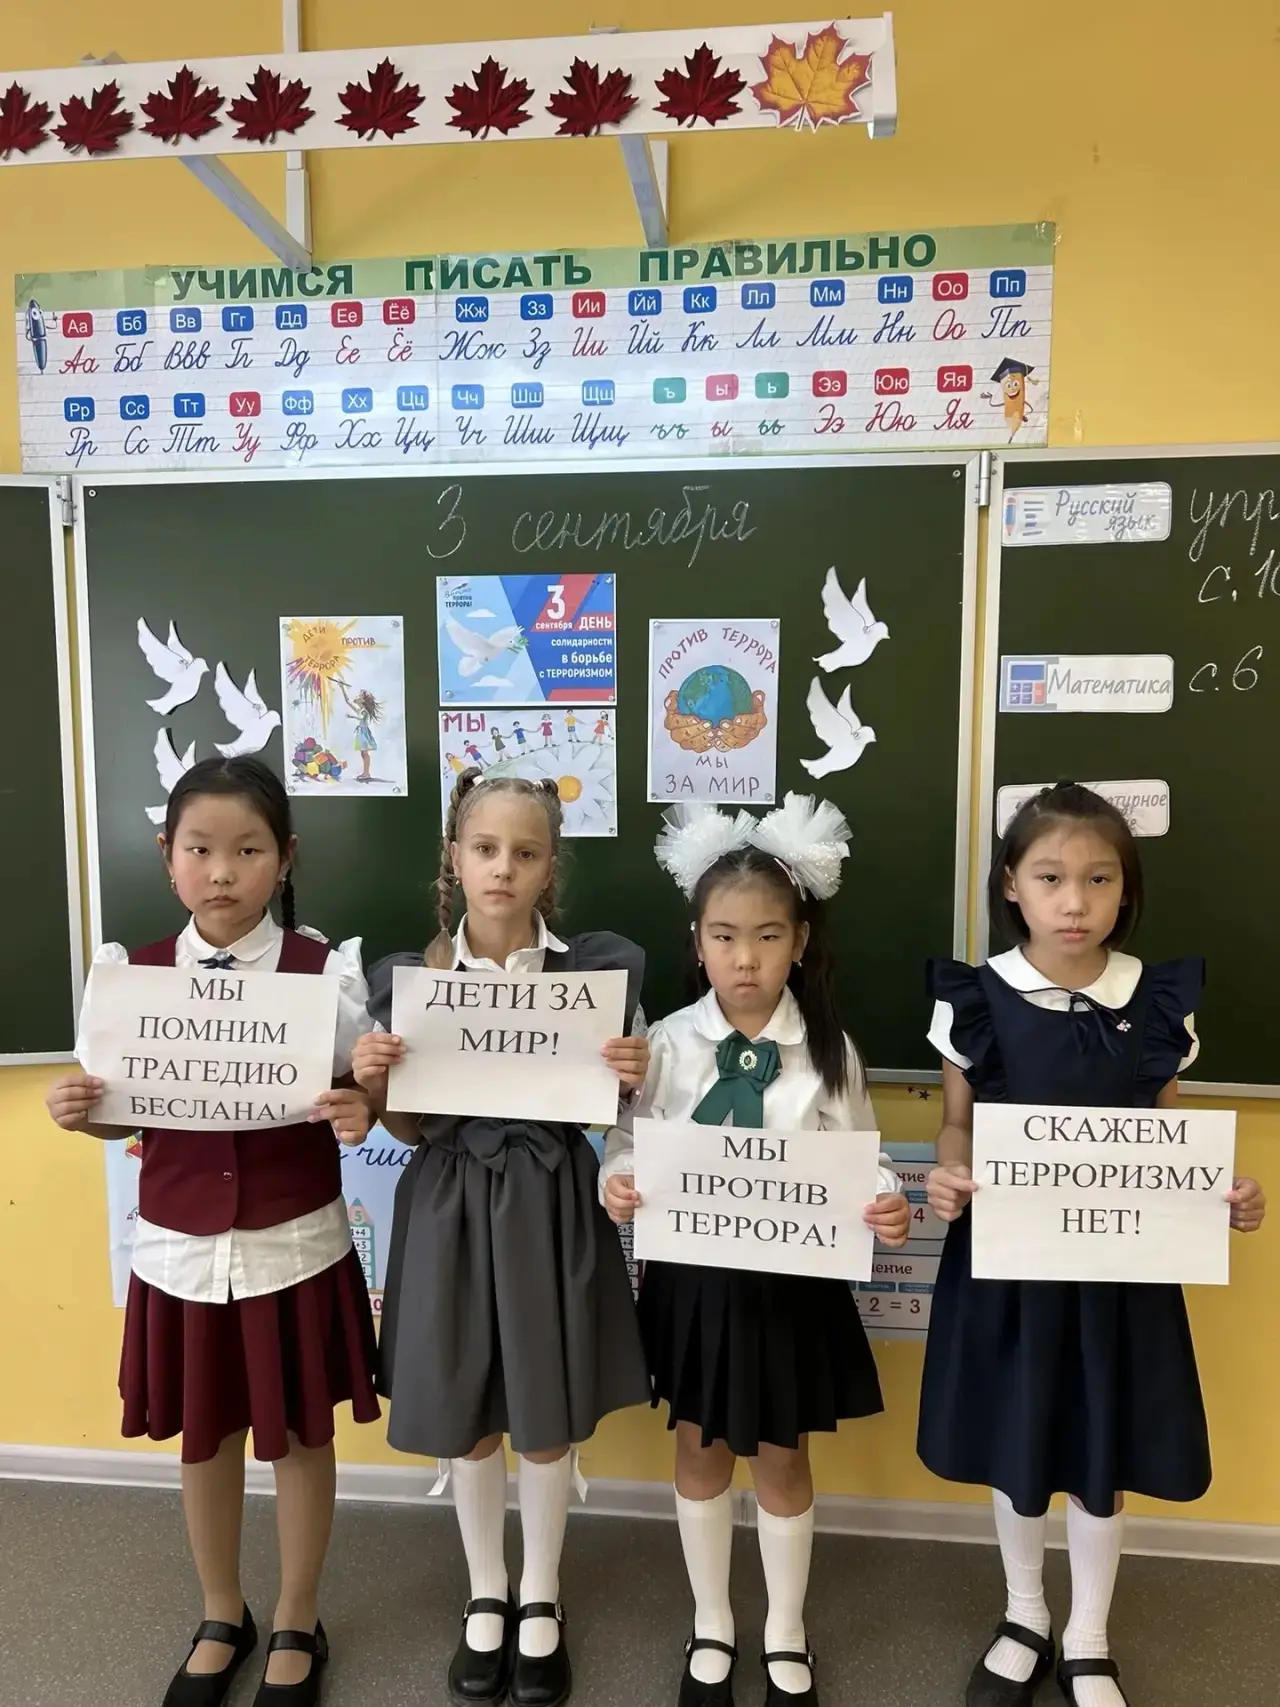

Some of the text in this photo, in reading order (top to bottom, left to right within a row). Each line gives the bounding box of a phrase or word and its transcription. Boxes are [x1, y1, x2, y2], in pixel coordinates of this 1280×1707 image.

[170, 233, 937, 300] УЧИМСЯ ПИСАТЬ ПРАВИЛЬНО
[68, 277, 1020, 334] Аа Бб Вв Гг Дд Ее Ёё Жж Зз Ии Йй Кк Лл Мм Нн Оо Пп
[59, 345, 100, 374] Аа
[114, 341, 154, 373] Бб
[225, 338, 254, 369] Гг
[275, 338, 310, 378] Дд
[336, 335, 361, 364] Ее
[388, 328, 413, 362] Ёё
[439, 330, 506, 360] Жж
[523, 327, 551, 369] Зз
[572, 327, 608, 356] Ии
[628, 319, 664, 354] Йй
[682, 320, 719, 352] Кк
[736, 318, 781, 348] Лл
[796, 314, 858, 346] Мм
[873, 310, 916, 343] Нн
[933, 308, 967, 341] Оо
[981, 305, 1032, 339] Пп
[70, 403, 90, 420] Рр
[125, 402, 145, 415] Сс
[180, 399, 199, 413] Тт
[236, 399, 255, 416] Уу
[285, 397, 311, 412] Фф
[348, 394, 367, 408] Хх
[402, 391, 424, 409] Цц
[458, 390, 478, 404] Чч
[513, 388, 542, 403] Шш
[583, 386, 614, 405] Щщ
[716, 384, 728, 396] ы
[768, 382, 776, 393] ь
[818, 377, 841, 392] Ээ
[876, 374, 908, 390] Юю
[943, 372, 966, 387] Яя
[65, 427, 98, 468] Рр
[124, 426, 149, 455] Сс
[163, 423, 220, 452] Тт
[232, 422, 262, 463] Уу
[280, 421, 318, 461] Фф
[336, 419, 382, 448] Хх
[394, 417, 435, 454] Цц
[456, 416, 487, 445] Чч
[504, 414, 555, 444] Шш
[571, 412, 630, 450] Щщ
[711, 421, 733, 437] ы
[814, 403, 845, 433] Ээ
[865, 401, 917, 432] Юю
[933, 398, 974, 430] Яя
[1056, 490, 1136, 526] Русский
[427, 484, 758, 568] 3 сентября
[1104, 515, 1156, 540] язык
[547, 585, 565, 619] 3
[303, 627, 326, 643] ДЕТИ
[536, 616, 612, 630] сентября ДЕНЬ
[342, 637, 376, 646] ПРОТИВ
[551, 638, 612, 646] солидарности
[658, 628, 777, 679] ПРОТИВ ТЕРРОРА
[305, 655, 340, 670] ТЕРРОРА
[562, 651, 612, 665] в борьбе
[1233, 645, 1263, 691] 6
[547, 669, 612, 678] ТЕРРОРИЗМОМ
[1048, 668, 1171, 694] Математика
[443, 713, 485, 732] МЫ
[696, 756, 728, 768] МЫ
[665, 774, 760, 796] ЗА МИР
[1105, 794, 1167, 809] атурное
[188, 977, 245, 1001] МЫ
[426, 980, 597, 1012] ДЕТИ ЗА
[137, 1016, 288, 1045] ПОМНИМ
[458, 1028, 559, 1055] МИР!
[123, 1057, 298, 1088] ТРАГЕДИЮ
[129, 1096, 286, 1121] БЕСЛАНА!
[1024, 1115, 1190, 1145] СКАЖЕМ
[356, 1147, 413, 1166] чис
[721, 1135, 788, 1162] МЫ
[986, 1160, 1224, 1191] ТЕРРОРИЗМУ
[680, 1172, 828, 1206] ПРОТИВ
[913, 1207, 925, 1223] 4
[1060, 1208, 1140, 1235] НЕТ!
[668, 1210, 837, 1248] ТЕРРОРА!
[356, 1241, 366, 1249] +3
[872, 1264, 912, 1274] ение
[910, 1300, 920, 1313] 3
